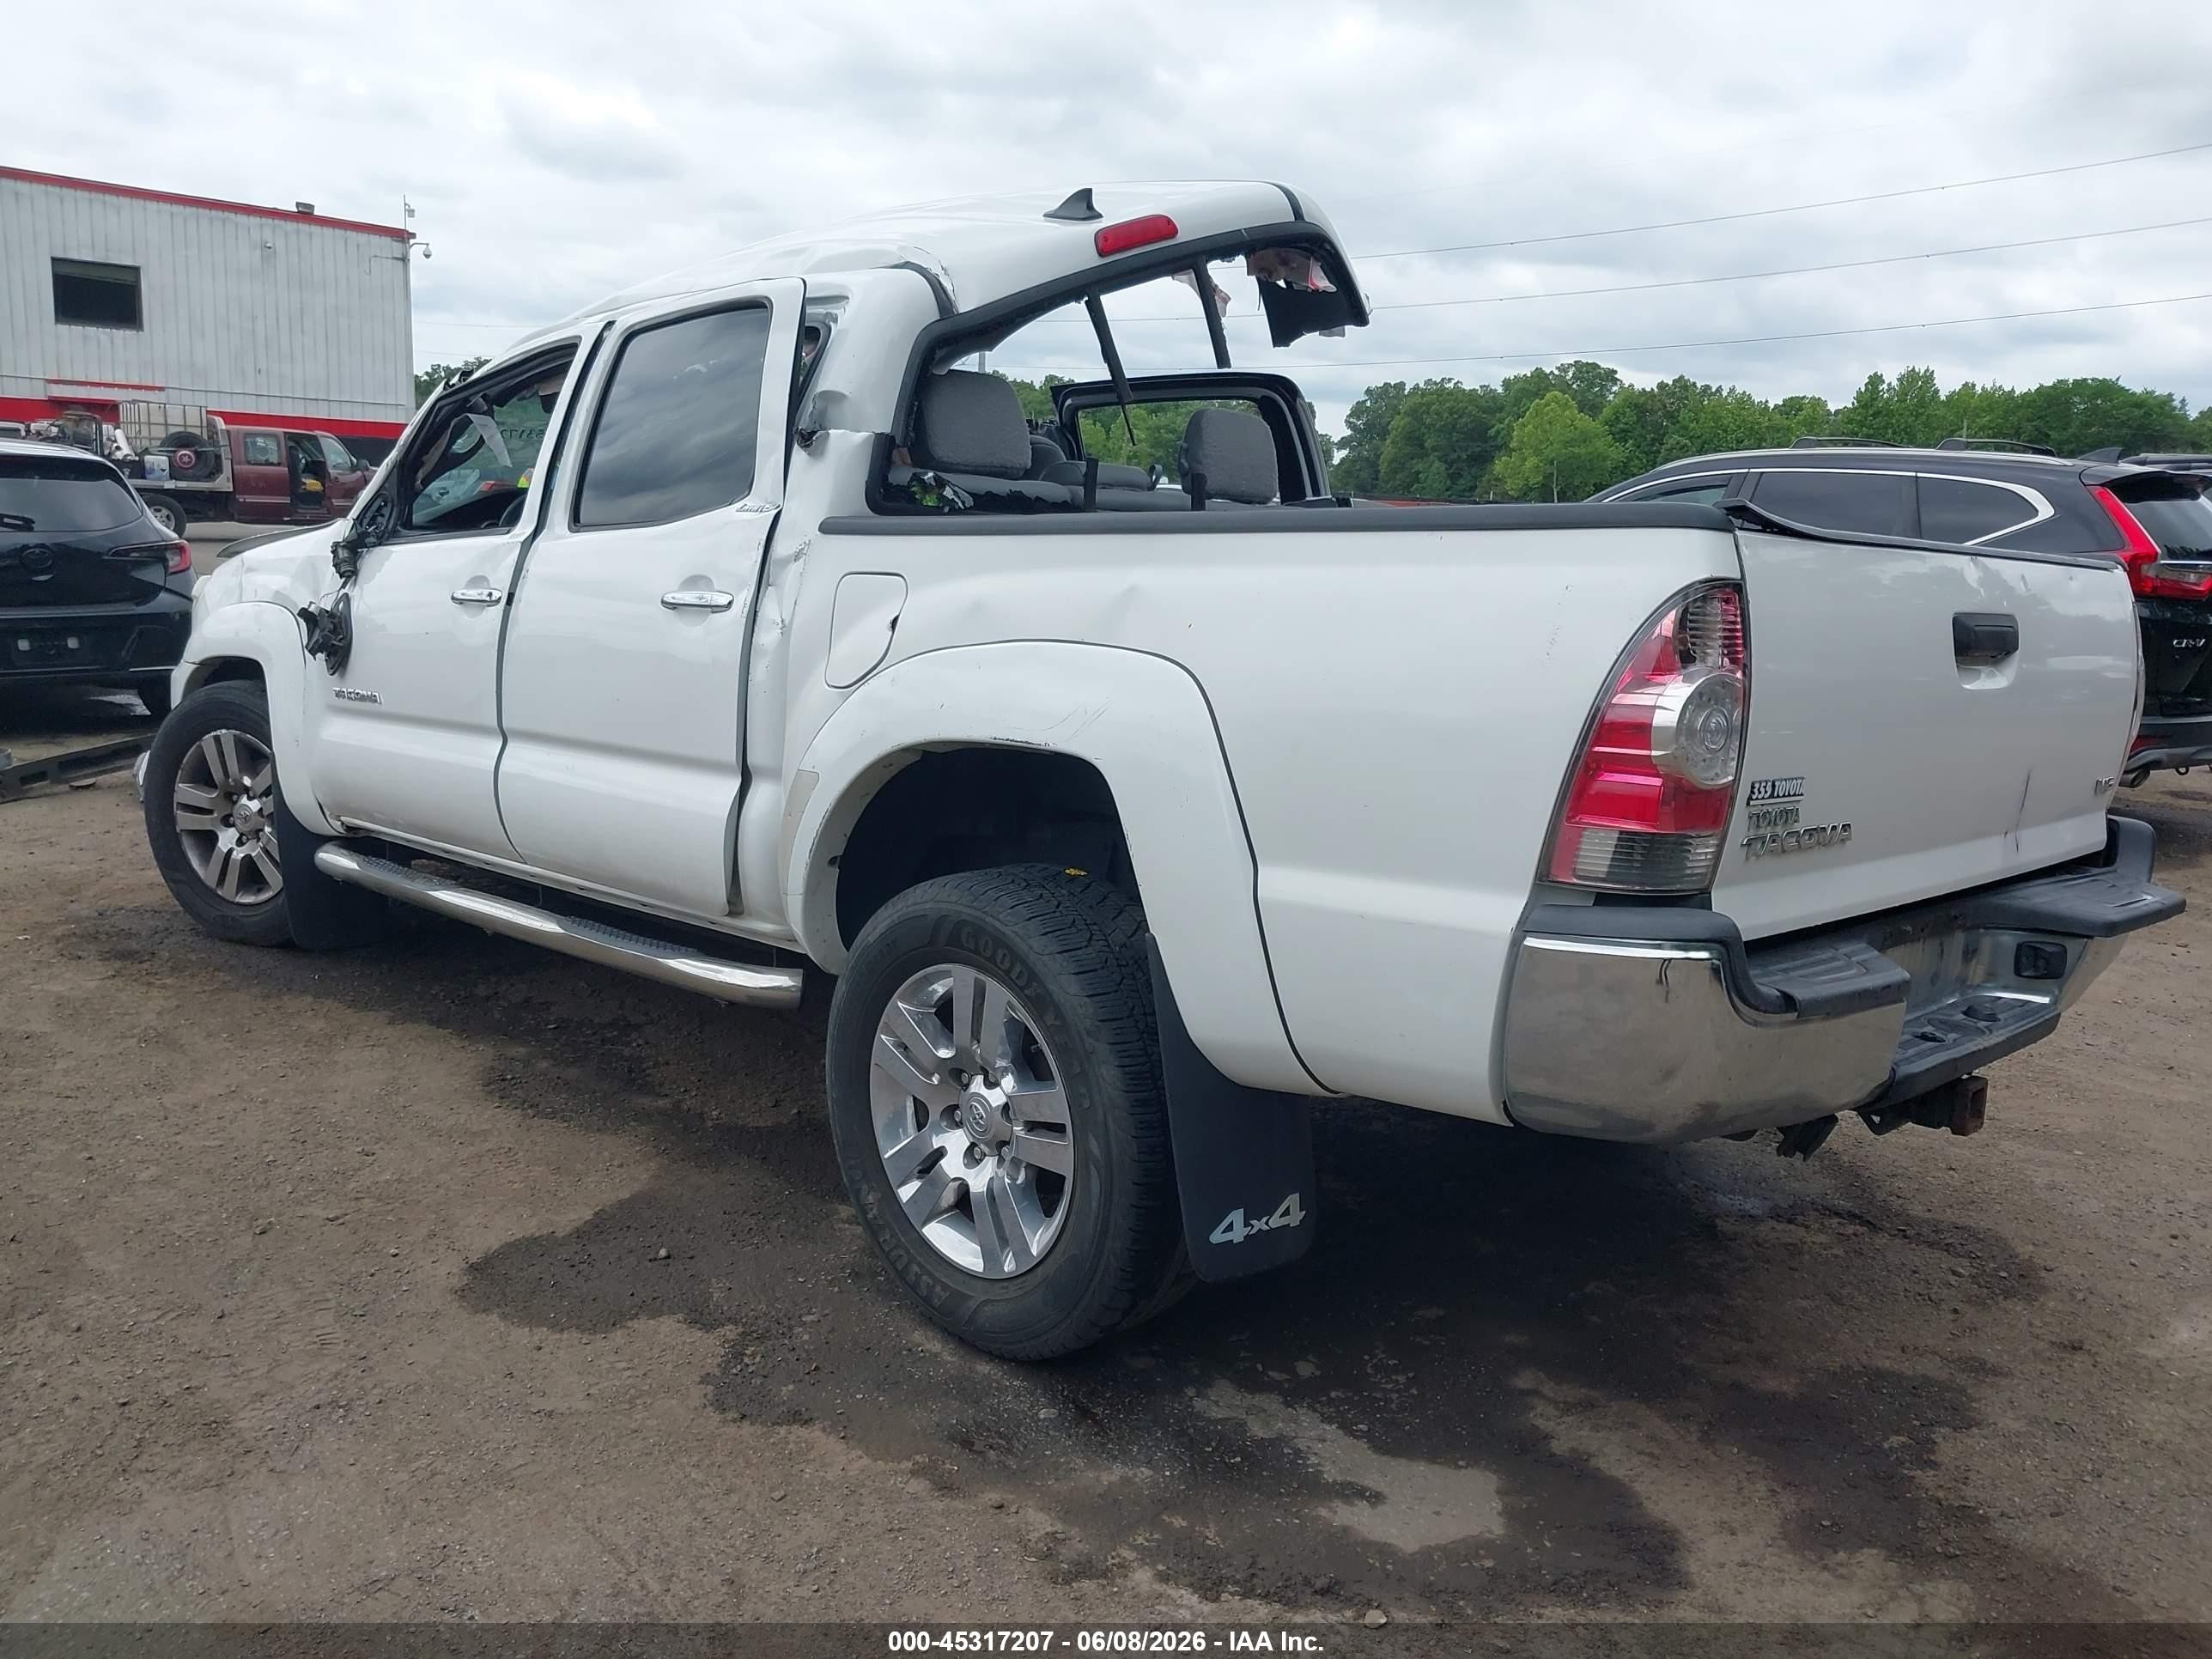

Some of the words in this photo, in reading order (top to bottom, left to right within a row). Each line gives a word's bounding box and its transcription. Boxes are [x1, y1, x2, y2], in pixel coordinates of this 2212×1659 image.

[1748, 807, 1800, 830] TOYOTA
[1741, 822, 1852, 858] TACOMA
[1208, 1192, 1306, 1244] 4x4
